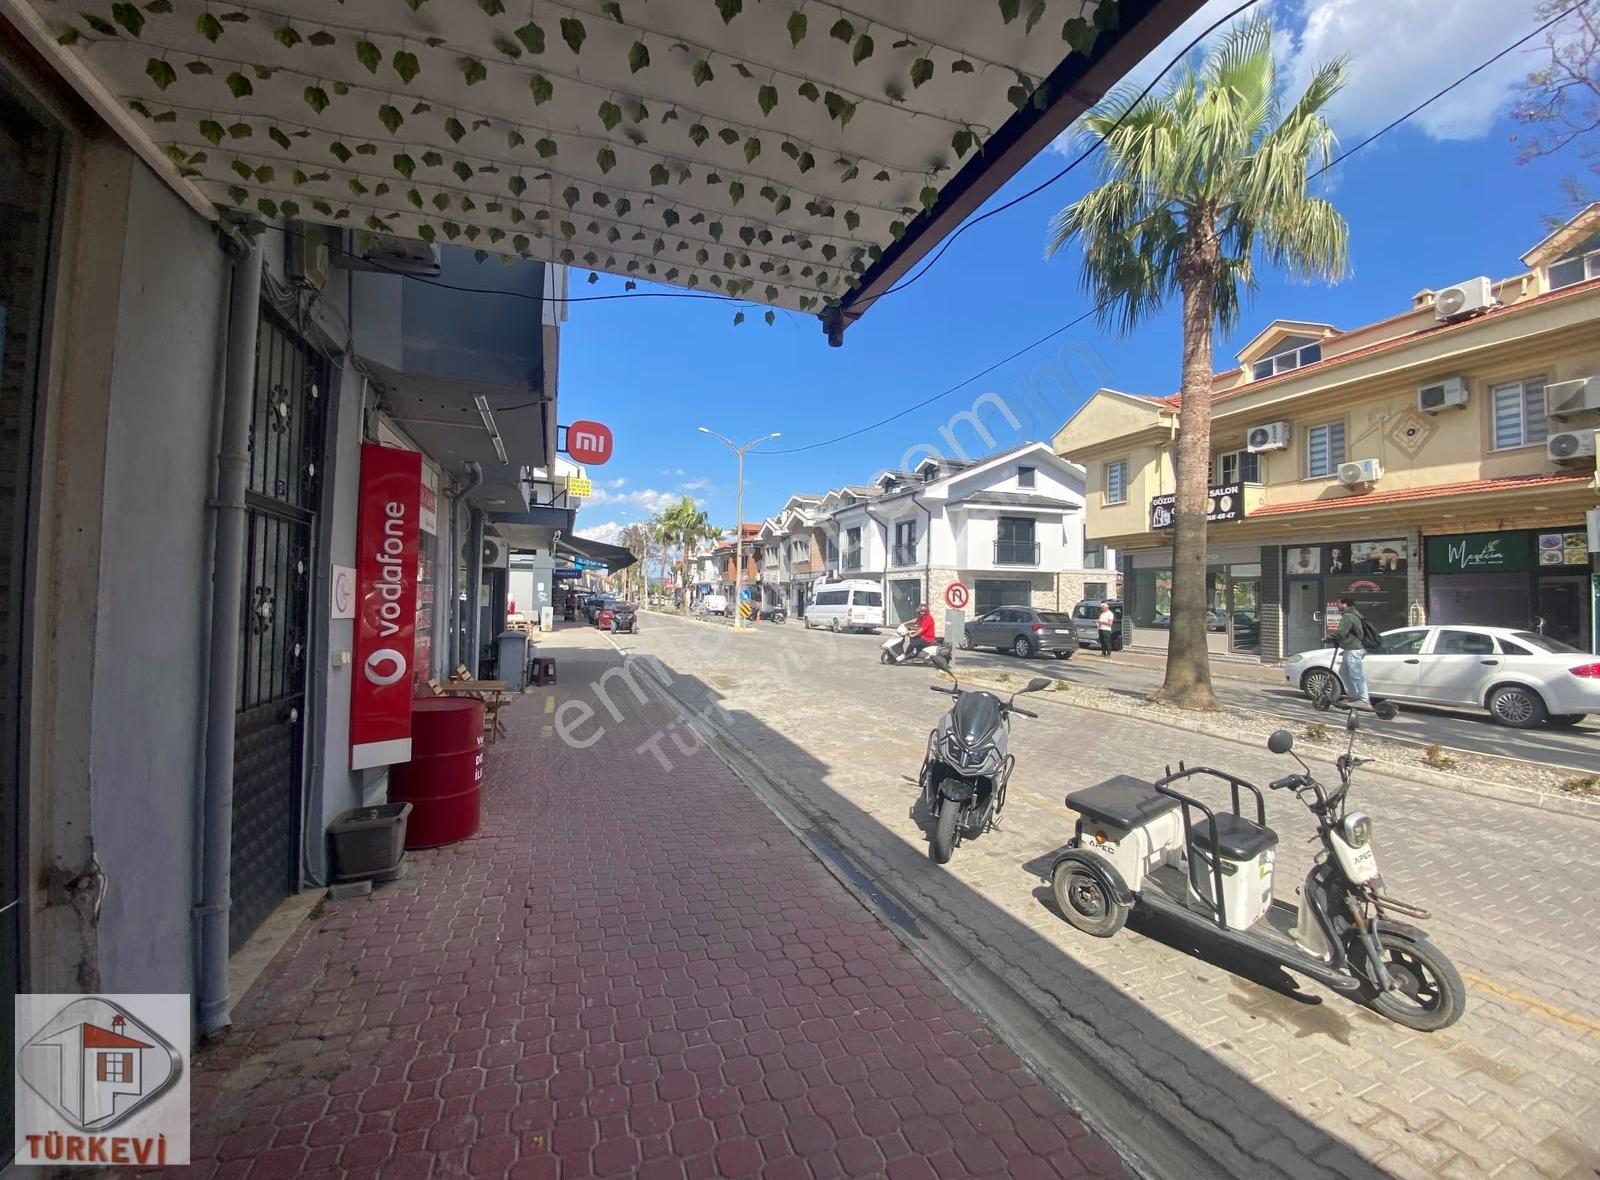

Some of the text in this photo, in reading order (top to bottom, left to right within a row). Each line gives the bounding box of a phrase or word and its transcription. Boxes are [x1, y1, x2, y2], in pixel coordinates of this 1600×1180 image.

[1209, 486, 1239, 497] SALON
[376, 501, 405, 638] vodafone
[1354, 850, 1372, 864] APEC
